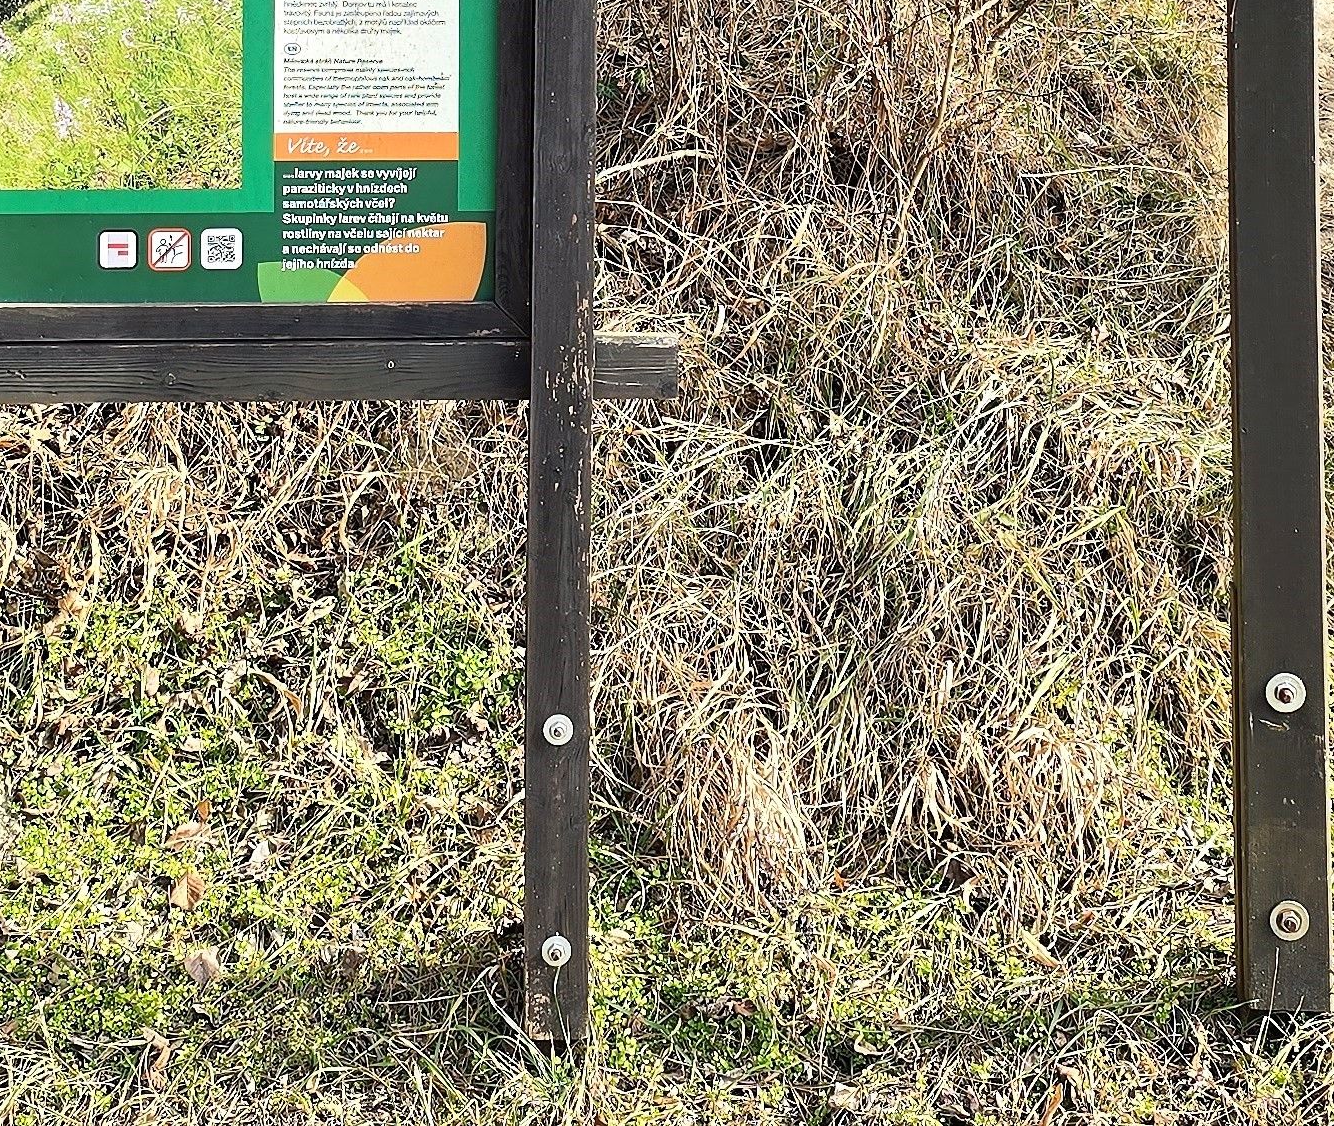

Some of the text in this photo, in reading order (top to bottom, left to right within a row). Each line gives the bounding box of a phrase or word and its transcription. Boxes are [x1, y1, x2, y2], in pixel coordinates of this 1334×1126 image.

[287, 137, 330, 157] Víte,
[325, 169, 361, 180] majek
[361, 171, 375, 179] se
[376, 168, 417, 181] vyvíjejí
[282, 183, 408, 196] paraziticky v hnízdech
[282, 198, 396, 210] samotářských včel?
[282, 213, 449, 226] Skupinky larev číhají na květu
[283, 228, 445, 241] rostliny na včelu sající nektar
[282, 244, 420, 256] a nechávají se odnést do
[281, 259, 314, 271] jejího
